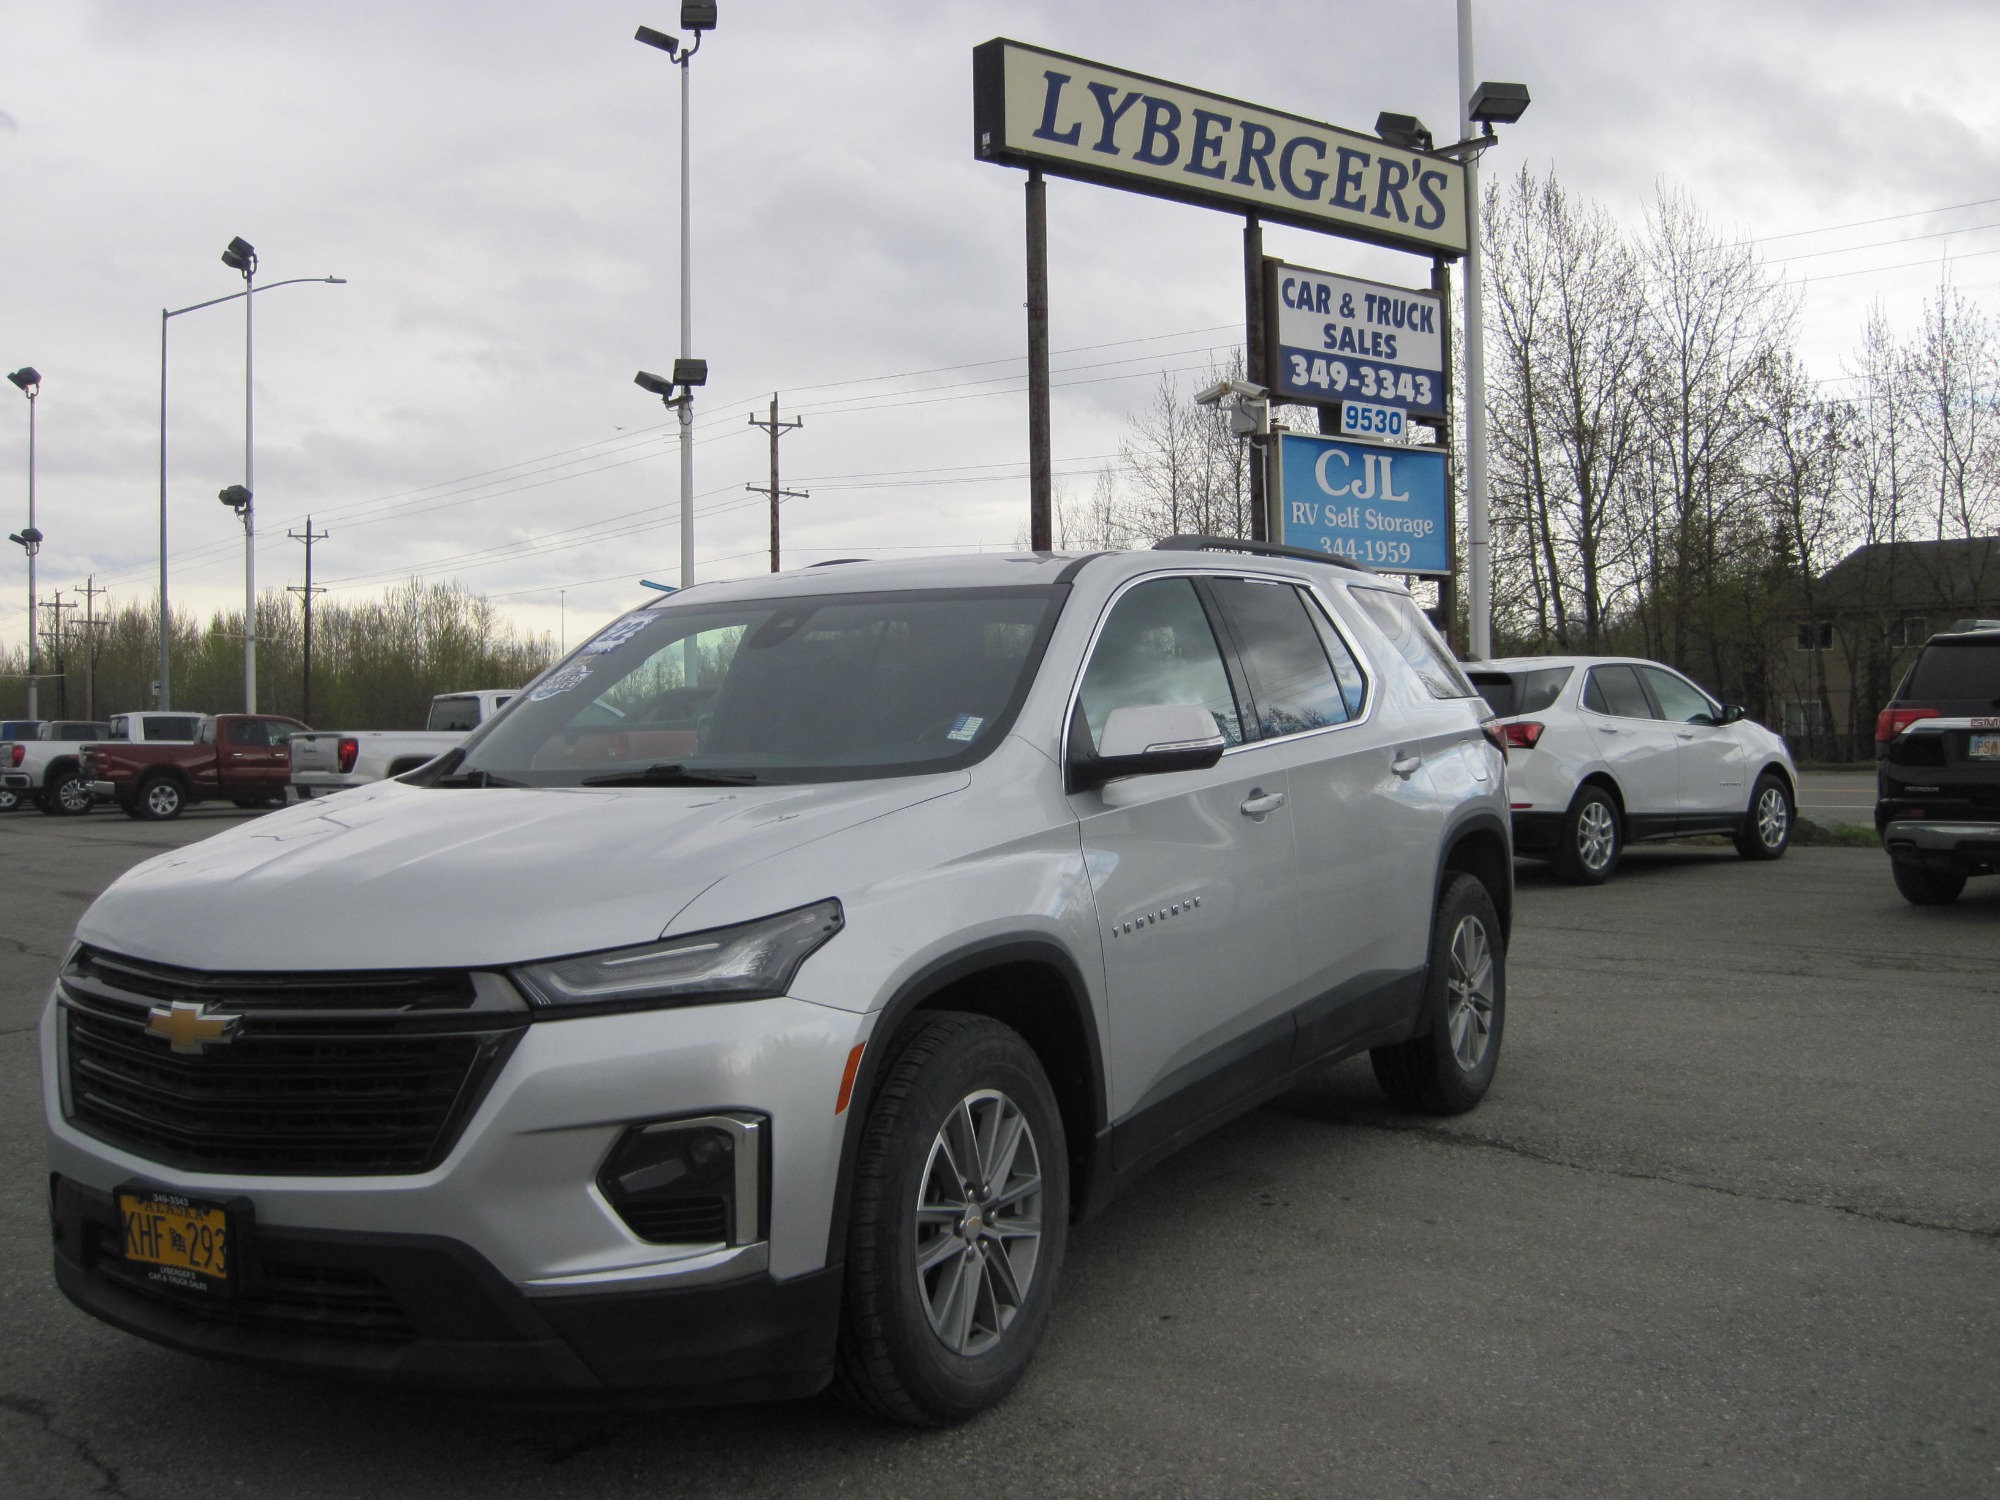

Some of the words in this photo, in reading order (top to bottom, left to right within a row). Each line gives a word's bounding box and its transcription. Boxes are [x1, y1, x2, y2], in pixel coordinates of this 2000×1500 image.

[1031, 69, 1448, 230] LYBERGER'S
[1281, 277, 1331, 315] CAR
[1339, 293, 1356, 319] &
[1364, 293, 1435, 334] TRUCK
[1323, 323, 1398, 360] SALES
[1290, 354, 1432, 405] 349-3343
[1345, 405, 1402, 435] 9530
[1315, 449, 1409, 502] CJL
[1292, 501, 1318, 525] RV
[1325, 505, 1360, 529] Self
[1365, 509, 1434, 538] Storage
[1320, 537, 1411, 563] 344-1959
[1971, 718, 2000, 727] GM
[1112, 897, 1201, 938] TRAVERSE
[144, 1201, 204, 1221] ALASKA
[153, 1193, 189, 1206] 349-3343
[122, 1210, 166, 1258] KHF
[186, 1221, 226, 1273] 293
[149, 1272, 161, 1281] CAR
[168, 1276, 189, 1285] TRUCK
[189, 1280, 208, 1290] SALES
